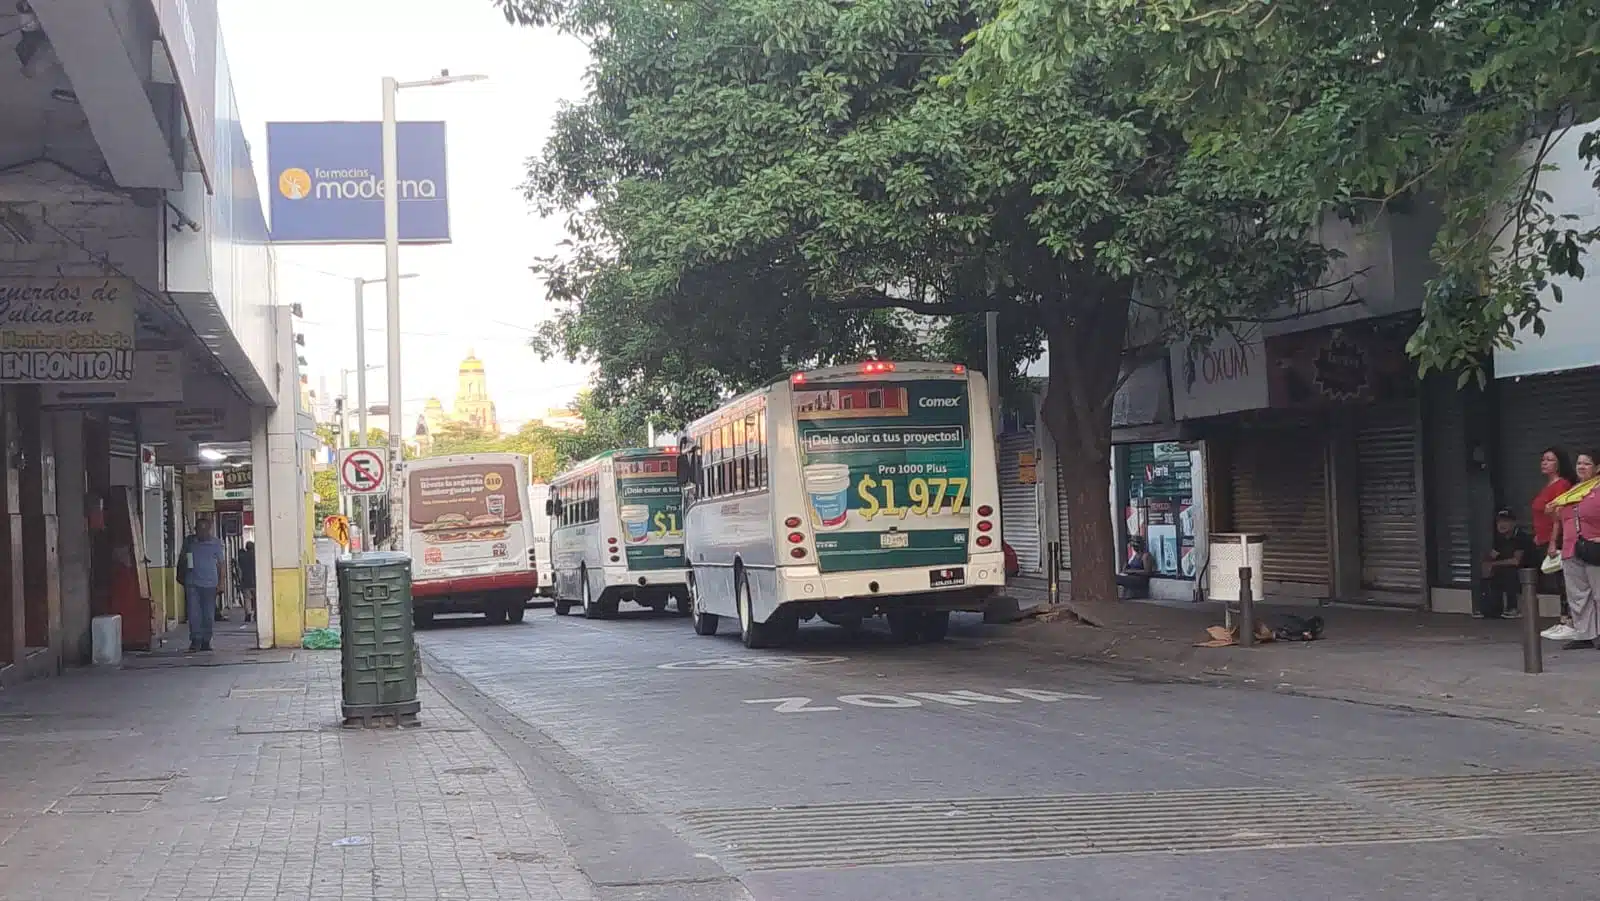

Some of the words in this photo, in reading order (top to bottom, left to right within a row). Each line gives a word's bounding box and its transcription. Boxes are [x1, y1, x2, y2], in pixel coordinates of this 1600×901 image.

[315, 168, 369, 179] farmacias
[91, 280, 119, 301] de
[65, 330, 132, 348] Grabado
[919, 396, 960, 408] Comex
[841, 433, 870, 444] color
[872, 434, 881, 443] a
[883, 431, 901, 444] tus
[903, 429, 960, 445] proyectos!
[878, 464, 896, 475] Pro
[898, 463, 924, 474] 1000
[926, 463, 947, 474] Plus
[858, 474, 968, 521] $1,977
[743, 687, 1103, 713] ZONA
